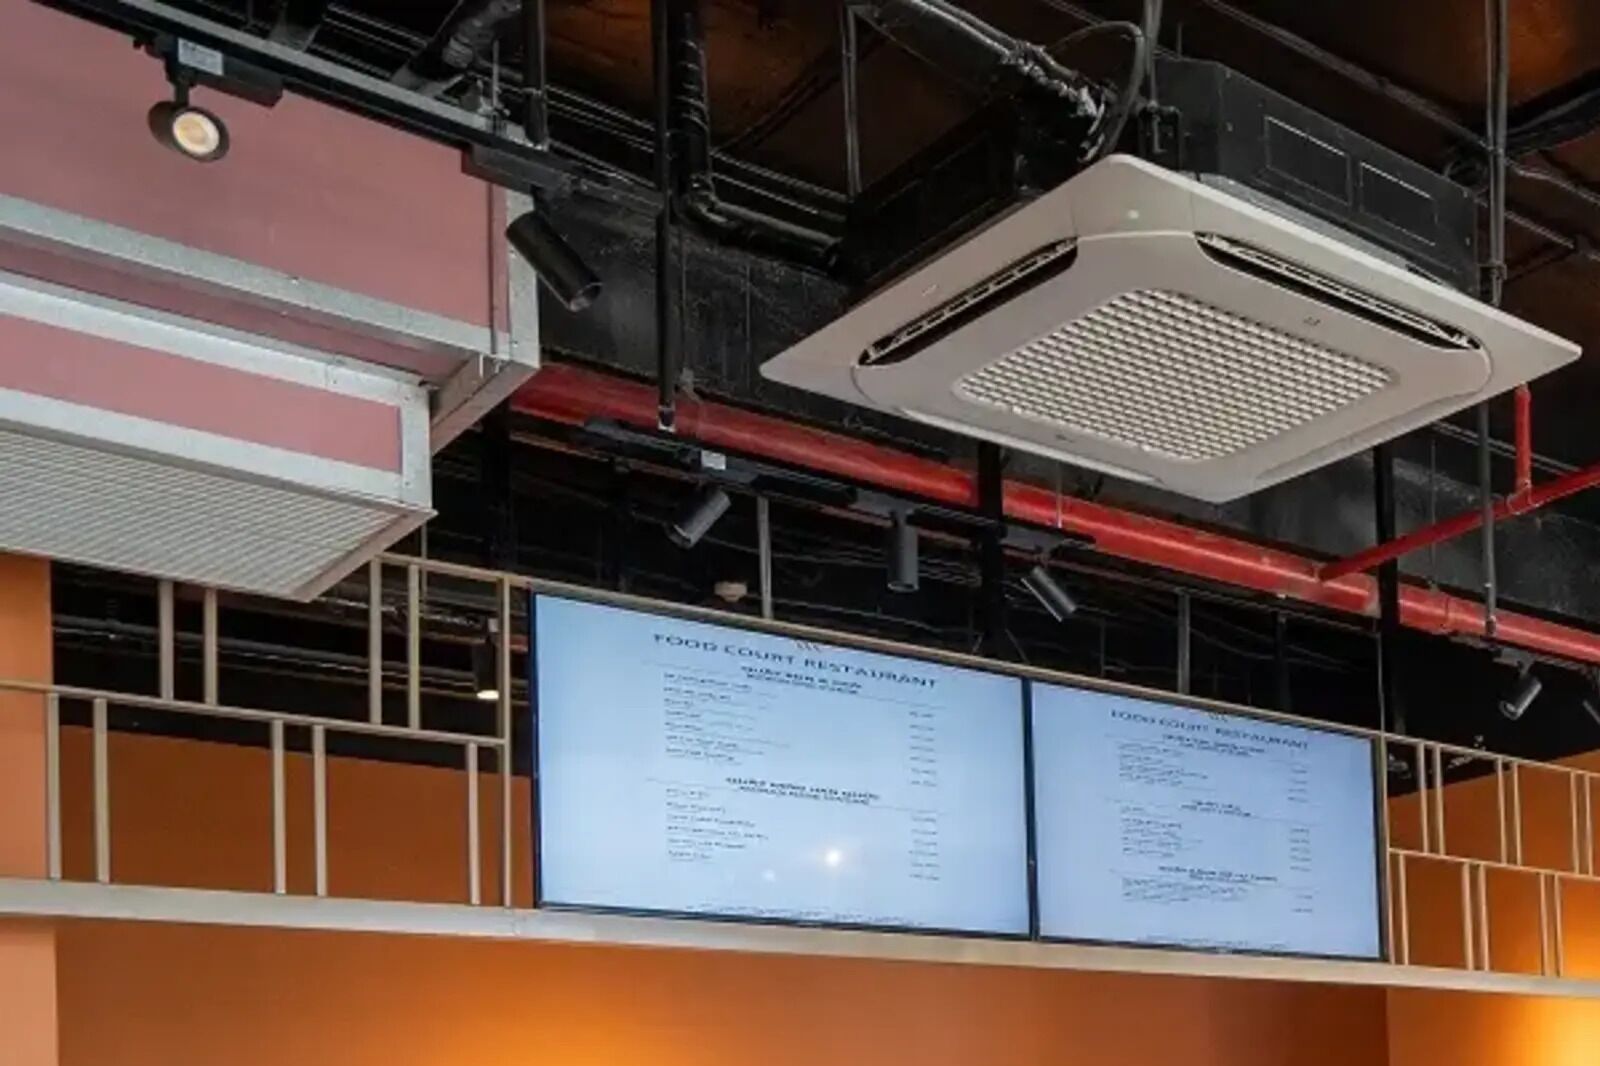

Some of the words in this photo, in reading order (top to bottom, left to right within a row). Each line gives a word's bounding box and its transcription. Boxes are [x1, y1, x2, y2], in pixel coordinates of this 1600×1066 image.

[653, 633, 718, 652] FOOD
[724, 644, 794, 665] COURT
[804, 657, 936, 689] RESTAURANT
